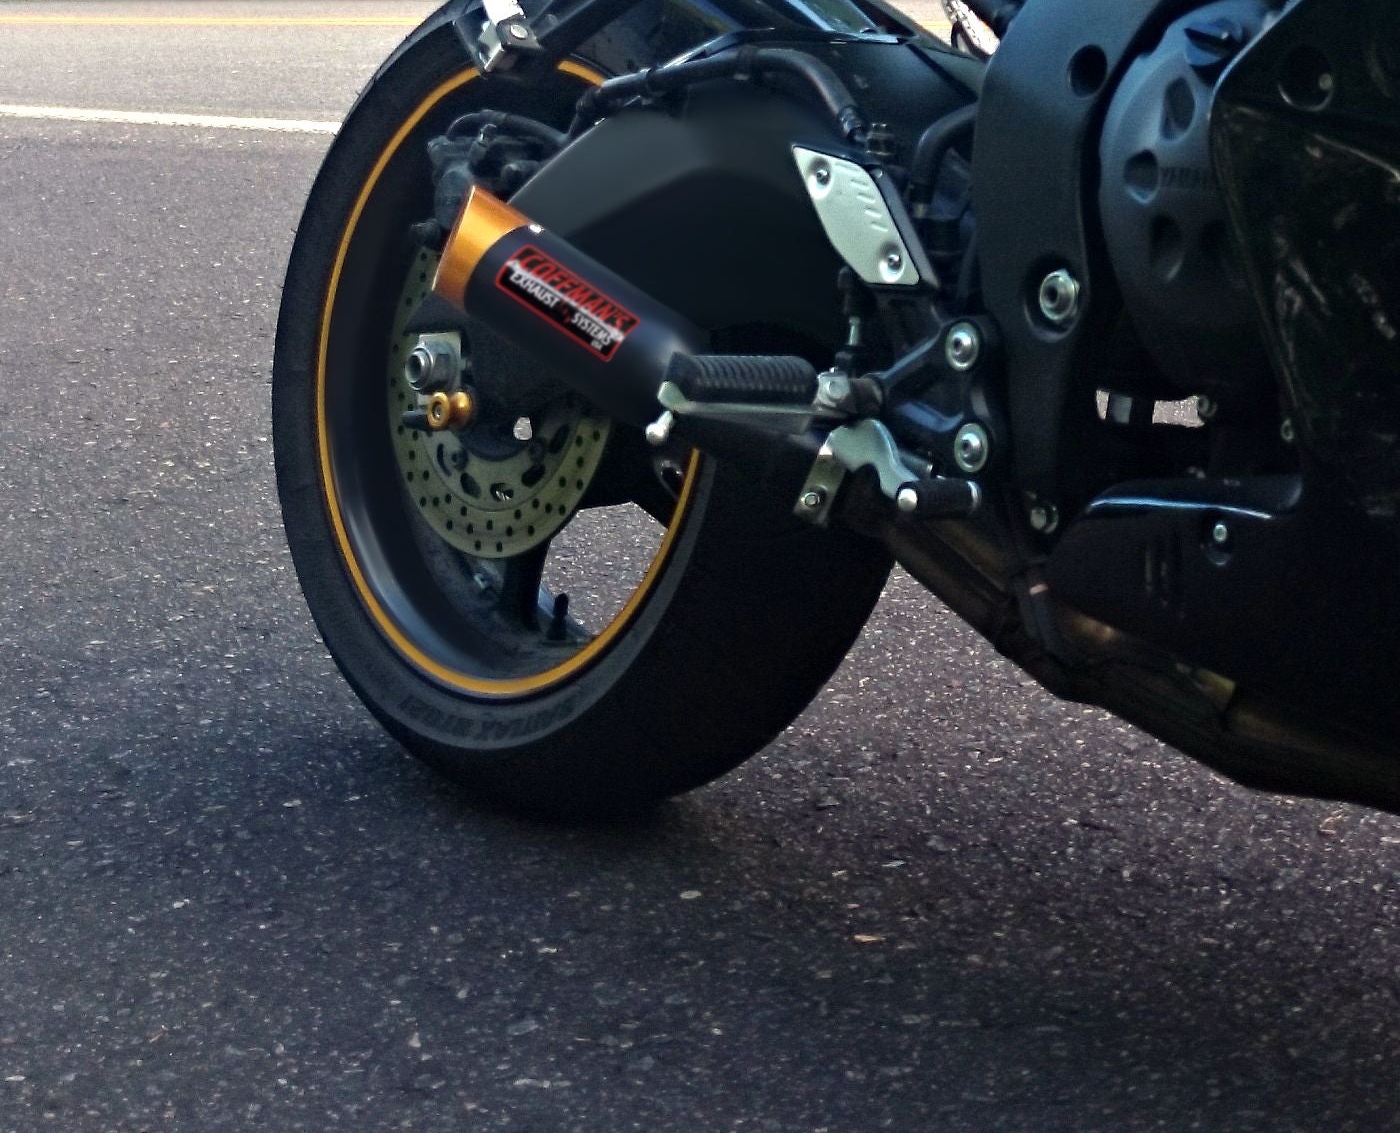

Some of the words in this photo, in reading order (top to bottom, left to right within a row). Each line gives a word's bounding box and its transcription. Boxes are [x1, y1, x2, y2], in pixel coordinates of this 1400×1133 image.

[509, 270, 560, 309] EXHAUST
[571, 312, 614, 346] SYSTEMS
[520, 254, 630, 330] COFFMAN'S
